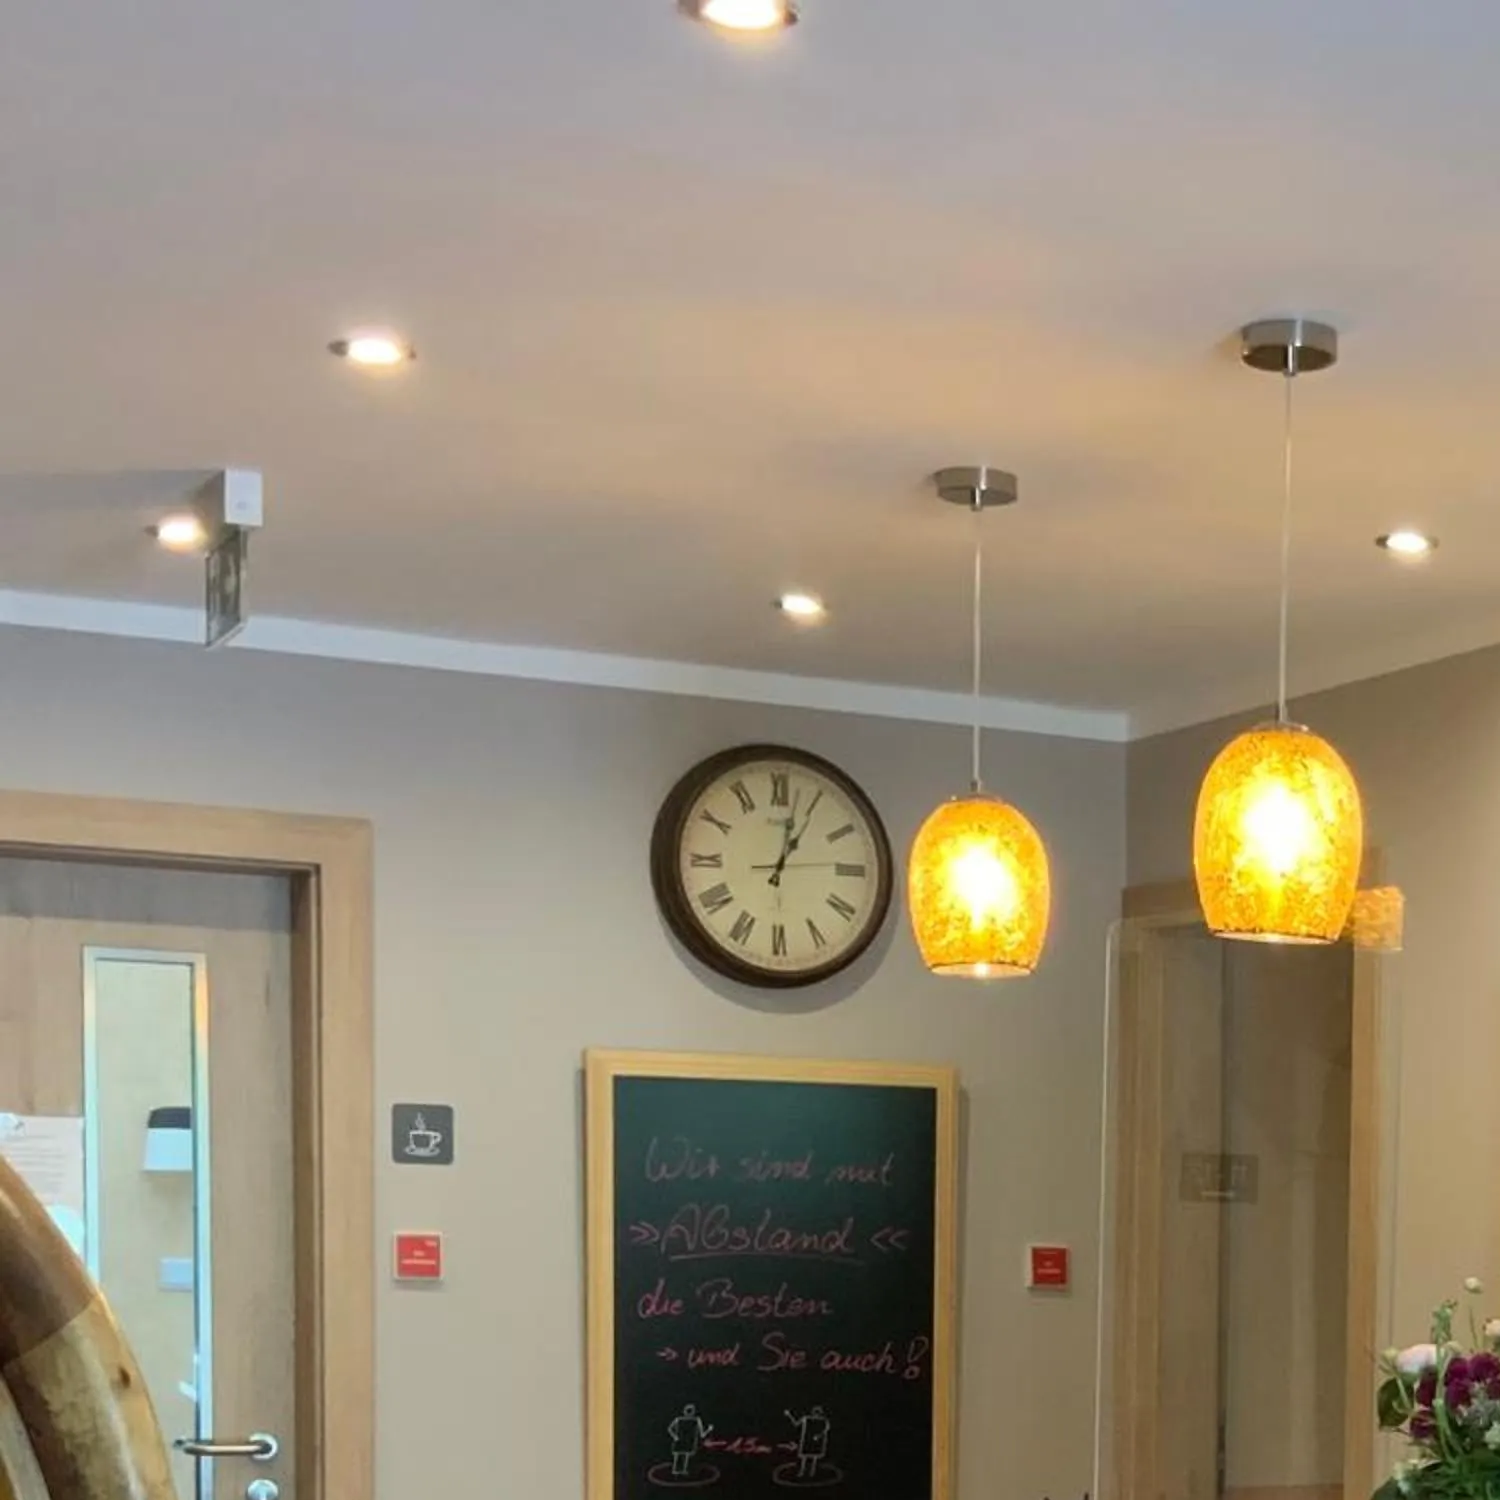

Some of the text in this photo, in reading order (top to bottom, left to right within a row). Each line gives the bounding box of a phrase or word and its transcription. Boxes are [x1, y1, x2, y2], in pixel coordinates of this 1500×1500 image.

[645, 1136, 720, 1182] Wir
[734, 1149, 814, 1181] sind
[637, 1278, 834, 1318] die Besten
[688, 1342, 740, 1368] und
[756, 1331, 806, 1370] Sie
